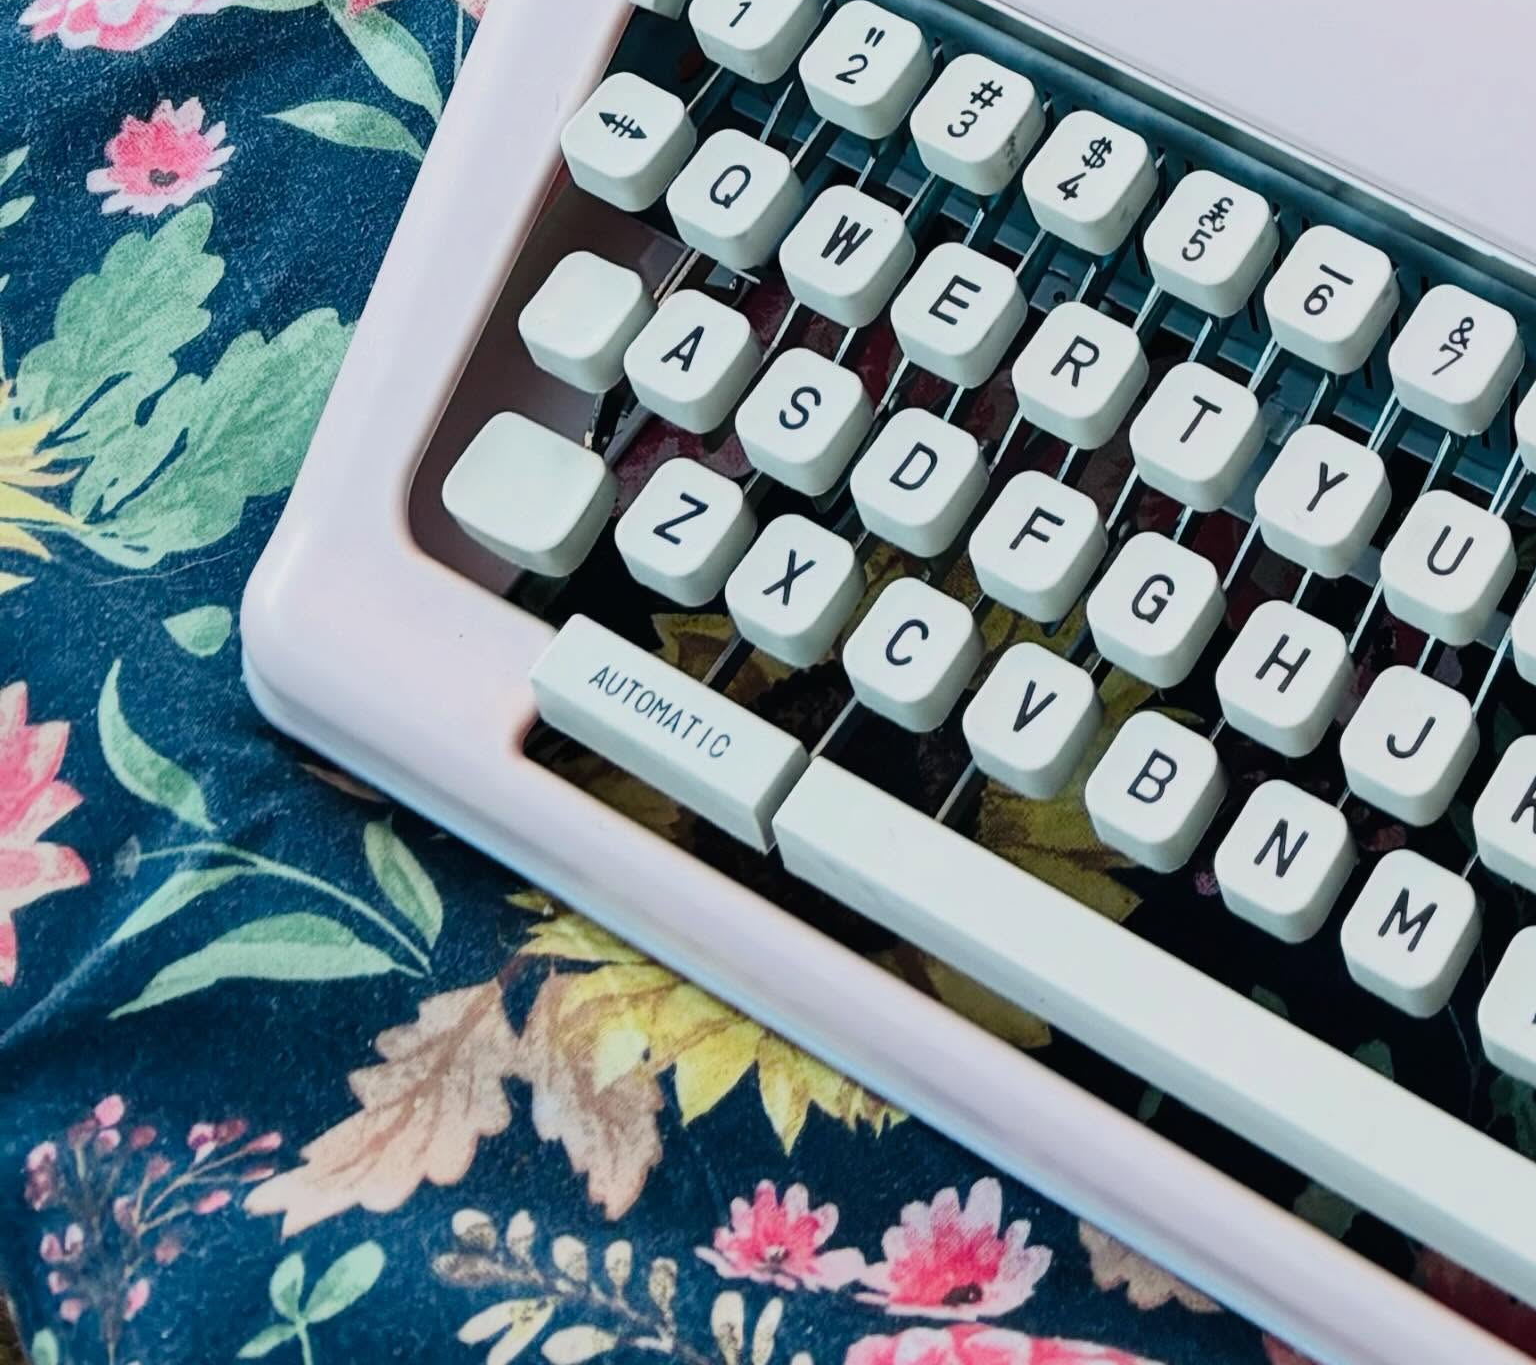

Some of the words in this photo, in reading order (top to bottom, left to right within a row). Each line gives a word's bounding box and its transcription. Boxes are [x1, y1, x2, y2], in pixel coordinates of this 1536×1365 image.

[729, 1, 752, 28] 1
[835, 53, 869, 85] 2
[969, 80, 1004, 110] #
[948, 110, 977, 138] 3
[1081, 136, 1113, 170] $
[709, 164, 752, 210] Q
[1056, 172, 1087, 201] 4
[820, 214, 874, 266] W
[1181, 228, 1213, 262] 5
[928, 274, 982, 326] E
[1303, 283, 1335, 316] 6
[660, 325, 705, 373] A
[1448, 316, 1475, 350] &
[1050, 335, 1100, 388] R
[1432, 344, 1464, 376] 7
[778, 386, 822, 430] S
[1179, 394, 1223, 444] T
[889, 441, 938, 491] D
[1306, 461, 1349, 512] Y
[652, 492, 709, 545] Z
[1009, 506, 1065, 551] F
[1426, 525, 1475, 576] U
[762, 548, 817, 606] X
[1131, 573, 1175, 625] G
[885, 618, 930, 667] C
[1255, 633, 1312, 694] H
[588, 665, 732, 760] AUTOMATIC
[1012, 680, 1058, 733] V
[1386, 716, 1437, 760] J
[1126, 748, 1178, 804] B
[1253, 818, 1309, 878] N
[1377, 887, 1438, 953] M
